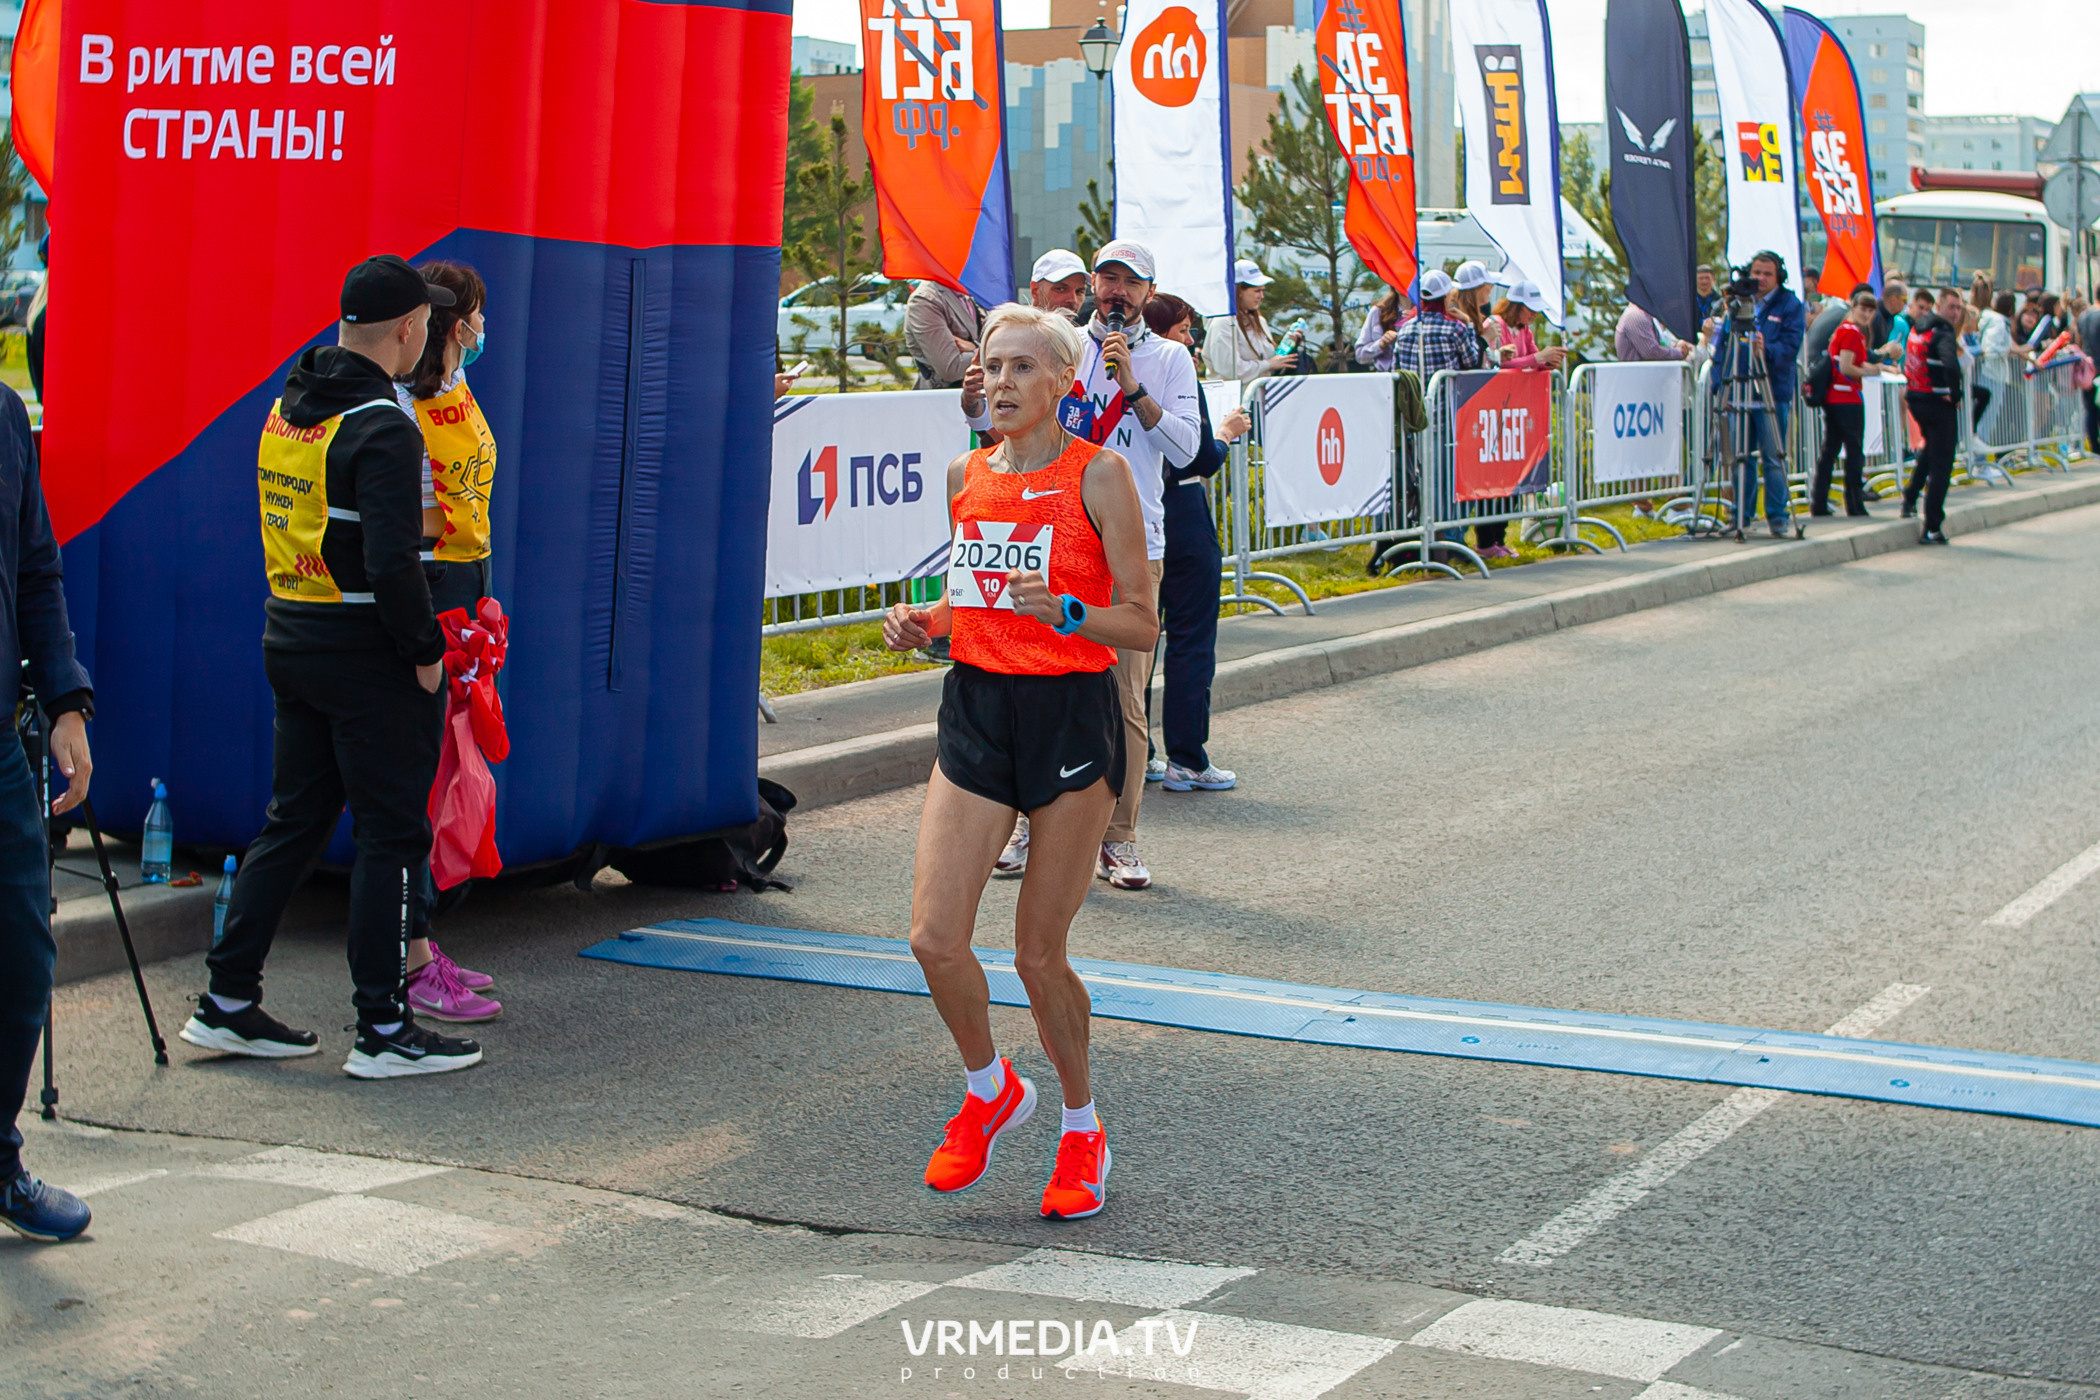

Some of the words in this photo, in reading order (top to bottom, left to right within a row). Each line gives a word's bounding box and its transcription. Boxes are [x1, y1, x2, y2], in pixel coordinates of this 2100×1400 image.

[79, 34, 114, 84] В
[127, 44, 275, 94] ритме
[289, 35, 397, 86] всей
[123, 107, 345, 162] СТРАНЫ!
[1613, 402, 1664, 439] OZON
[1321, 427, 1342, 466] hh
[277, 472, 315, 496] ГОРОДУ
[850, 452, 924, 508] ПСБ
[265, 490, 294, 511] НУЖЕН
[265, 511, 289, 532] ГЕРОЙ
[953, 542, 1043, 572] 20206
[982, 578, 1001, 593] 10
